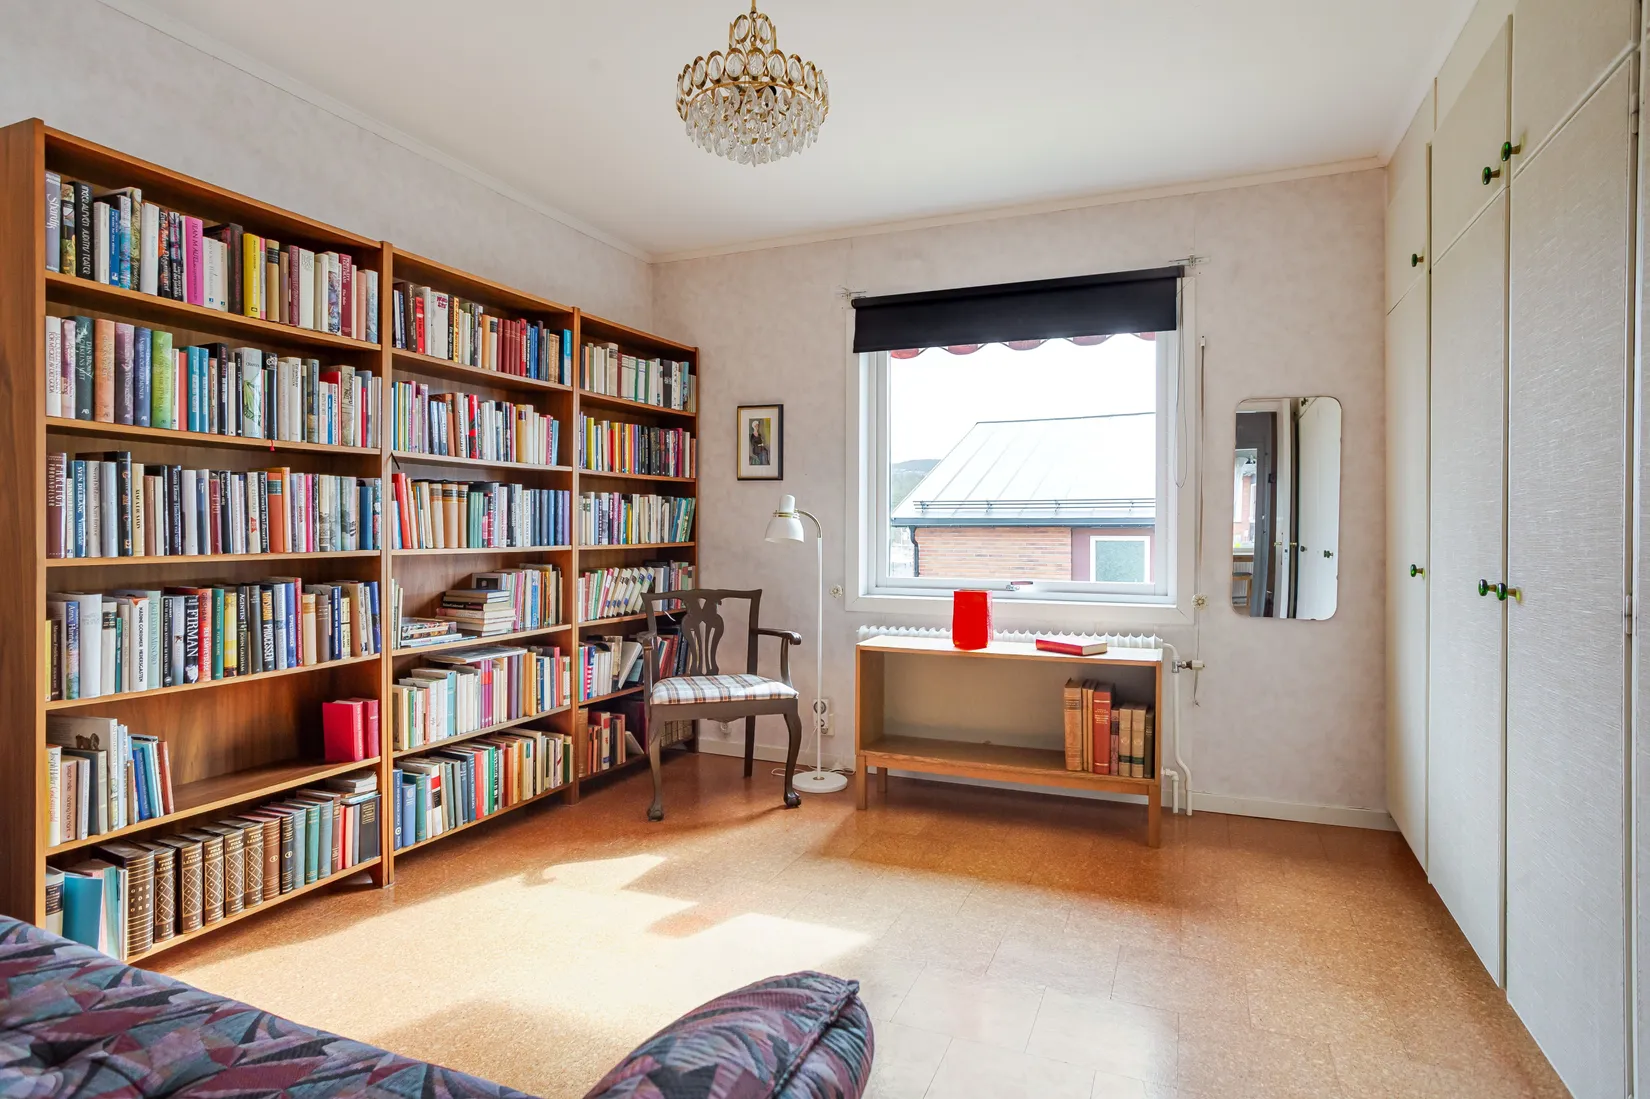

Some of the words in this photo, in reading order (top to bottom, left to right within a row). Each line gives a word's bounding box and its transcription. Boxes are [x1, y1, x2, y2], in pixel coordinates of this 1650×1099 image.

[56, 464, 64, 507] FARLIGA
[187, 609, 198, 656] FIRMAN
[264, 624, 273, 661] PROCESSEN
